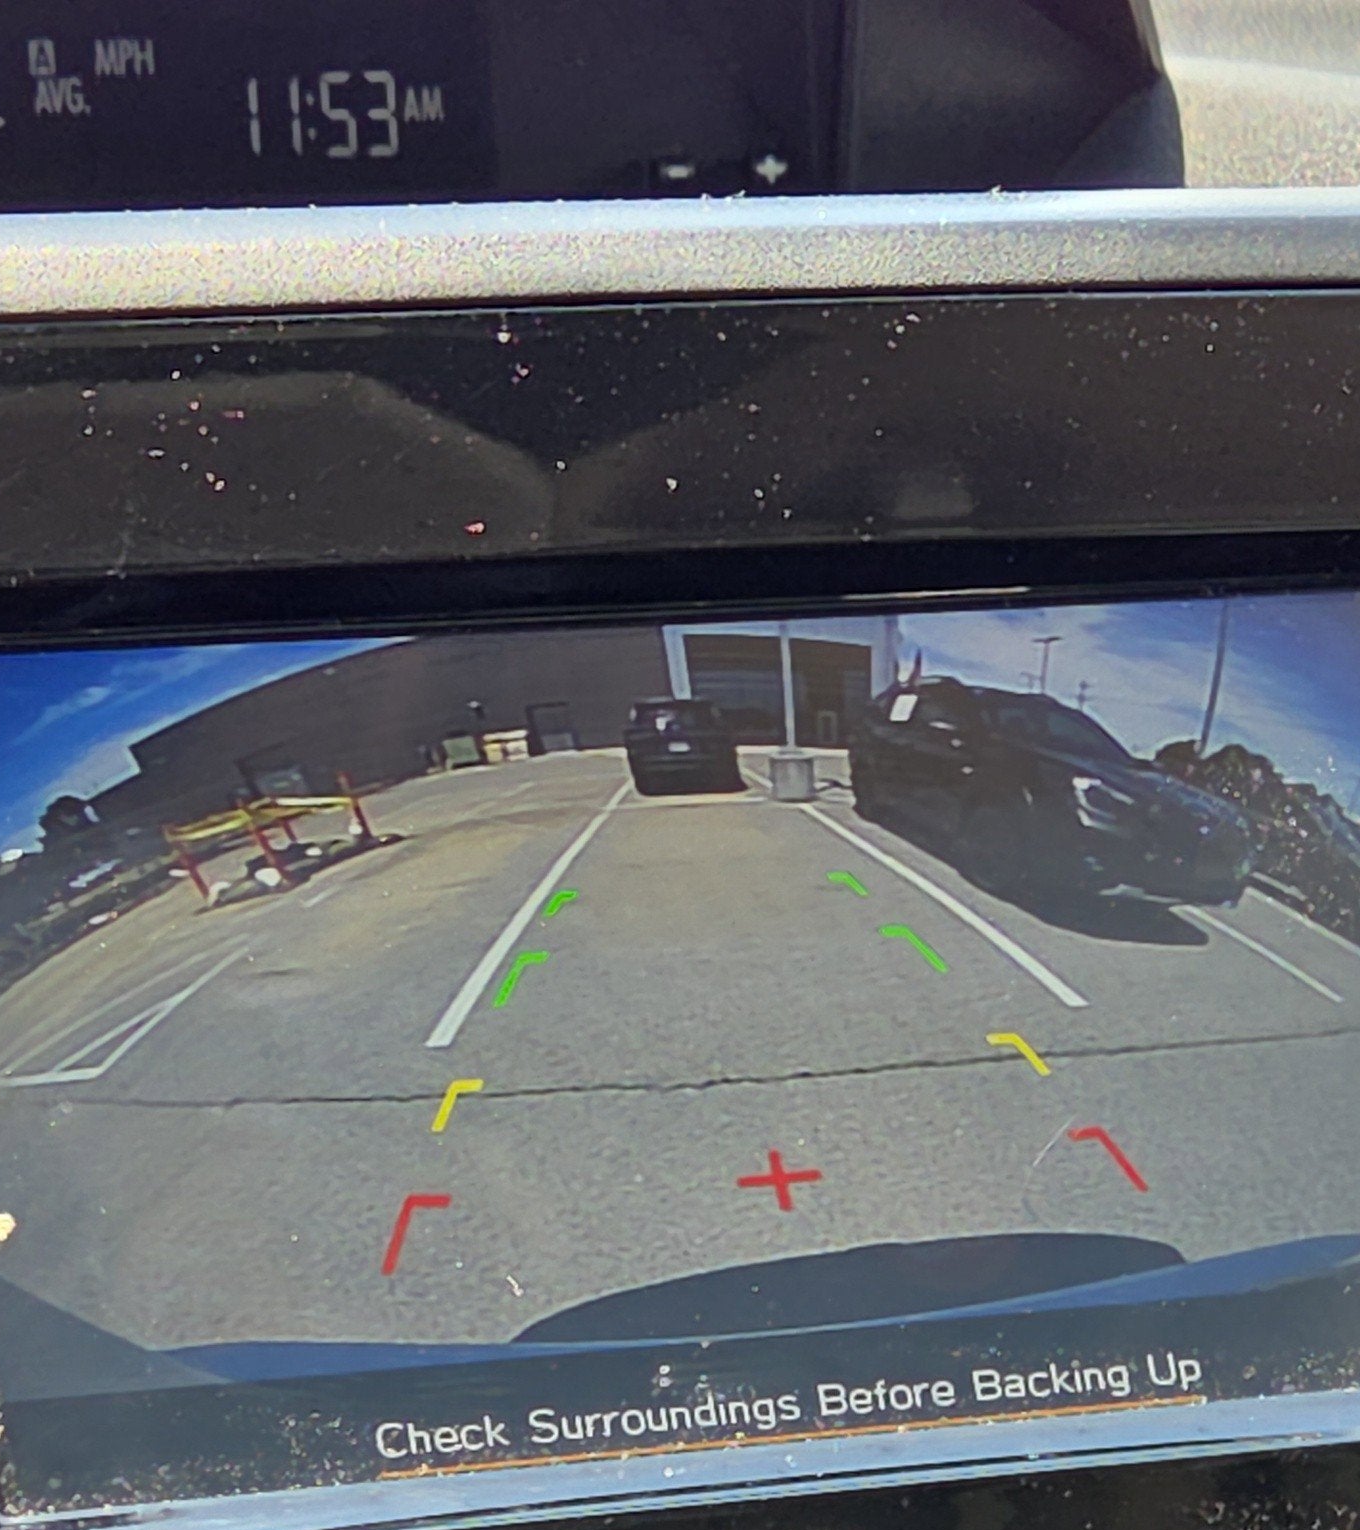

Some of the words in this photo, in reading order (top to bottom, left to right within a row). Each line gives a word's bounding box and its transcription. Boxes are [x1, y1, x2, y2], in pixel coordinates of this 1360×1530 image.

[95, 39, 157, 76] MPH
[35, 77, 92, 116] AVG.
[247, 70, 400, 157] 11:53
[403, 85, 446, 124] AM
[375, 1419, 508, 1460] Check
[530, 1393, 804, 1443] Surroundings
[820, 1377, 957, 1416] Before
[972, 1363, 1132, 1408] Backing
[1148, 1350, 1205, 1390] Up
